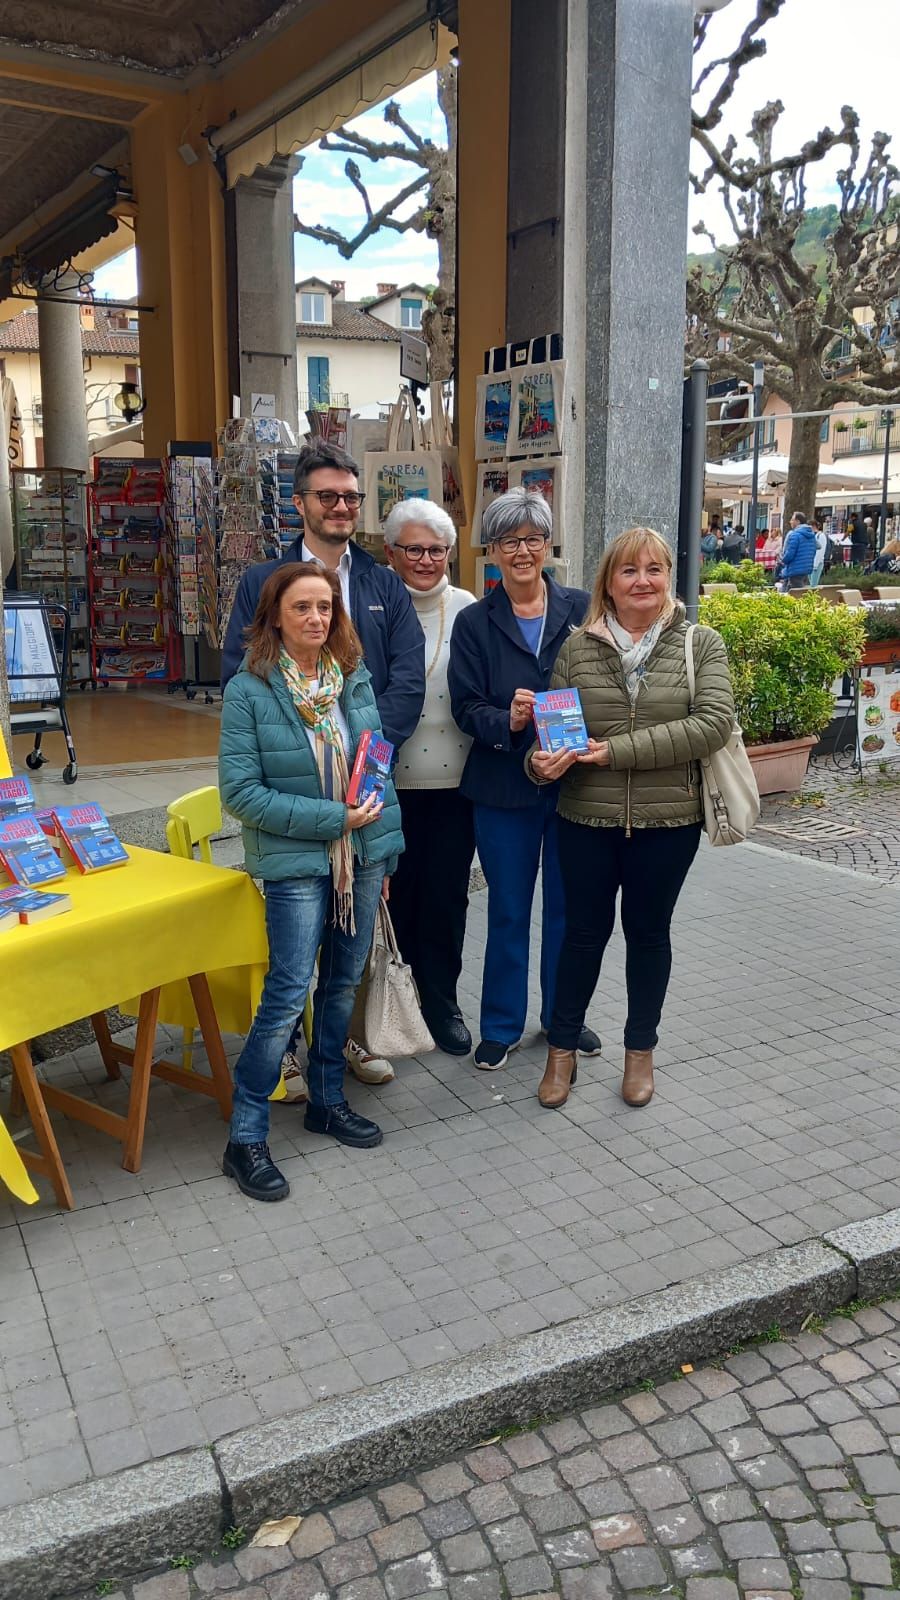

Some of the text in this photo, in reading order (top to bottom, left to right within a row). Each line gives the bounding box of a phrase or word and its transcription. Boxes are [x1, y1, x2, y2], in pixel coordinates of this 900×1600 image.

[382, 464, 425, 477] STRESA
[24, 621, 41, 660] MAGGIORE
[539, 703, 548, 713] DI
[551, 701, 570, 711] LAGO
[66, 816, 78, 827] DI
[78, 815, 96, 825] LAGO
[12, 829, 32, 840] LAGO
